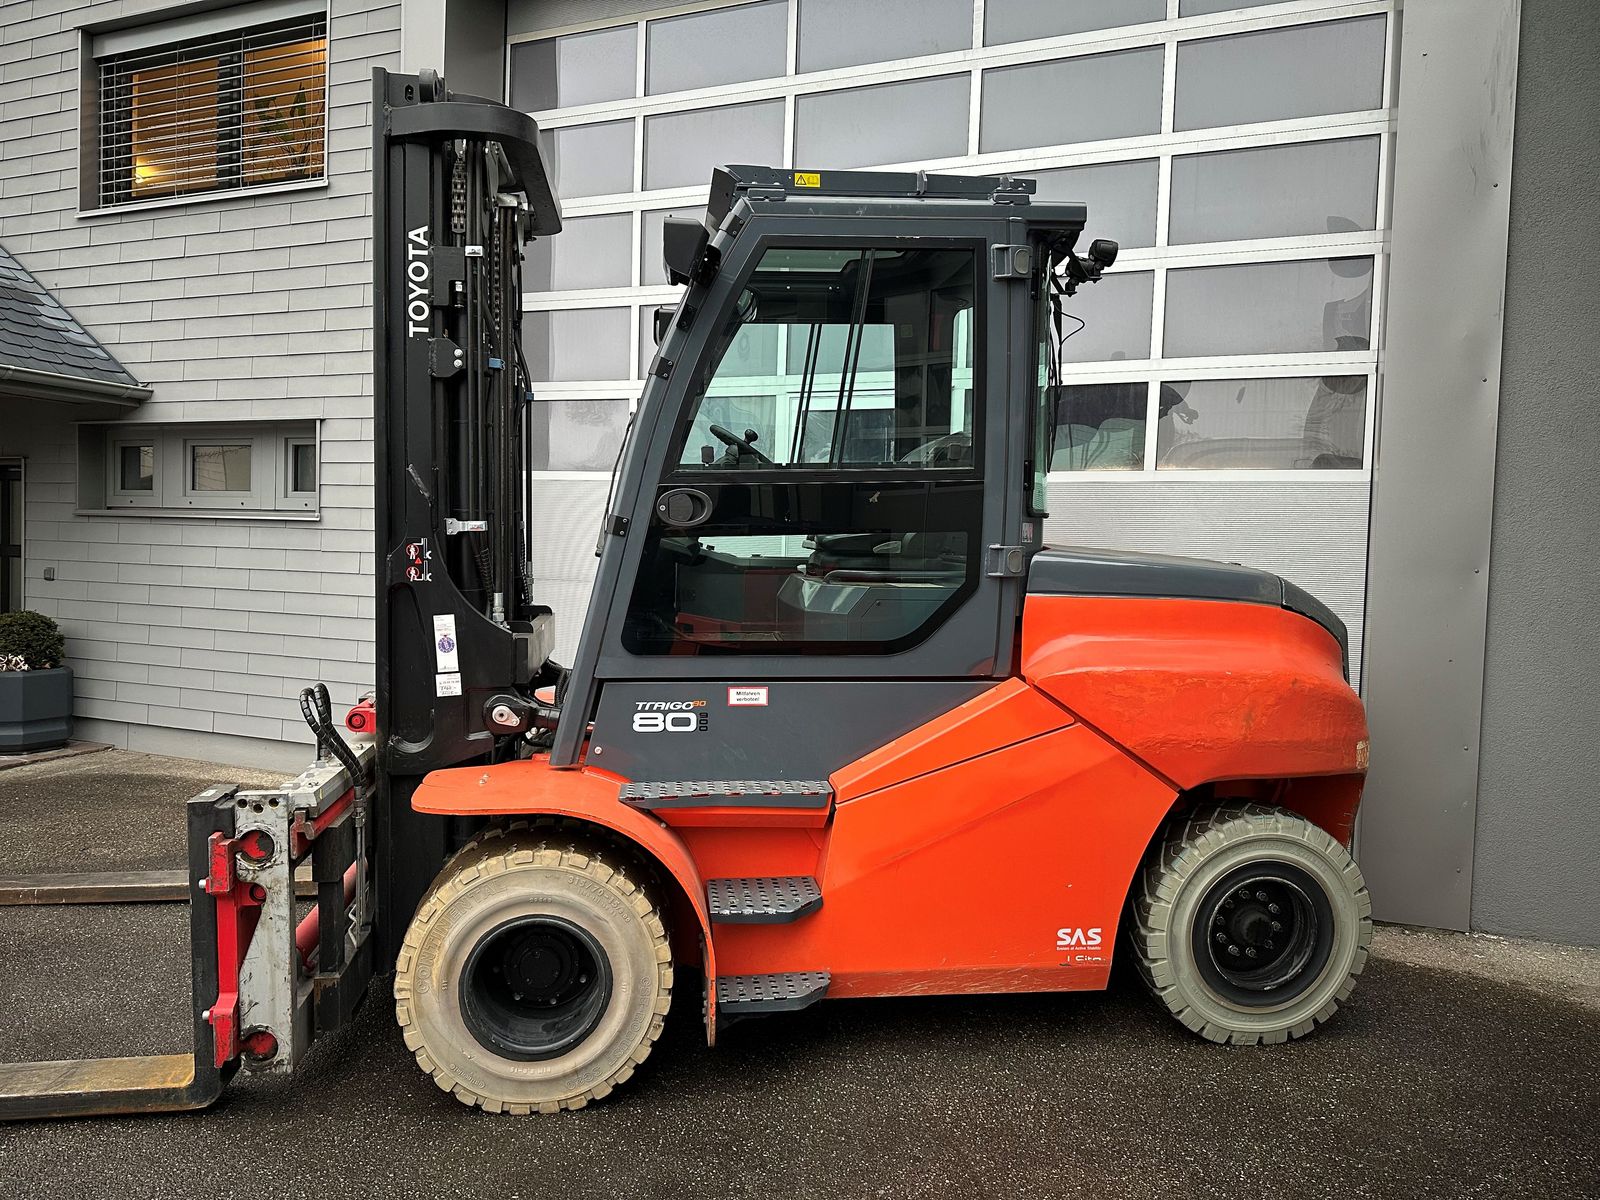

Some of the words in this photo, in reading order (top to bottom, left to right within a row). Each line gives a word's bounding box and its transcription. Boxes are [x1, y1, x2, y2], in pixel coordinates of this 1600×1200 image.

[408, 225, 430, 338] TOYOTA
[632, 712, 697, 732] 80
[415, 881, 508, 994] CONTINENTAL
[1056, 928, 1102, 945] SAS
